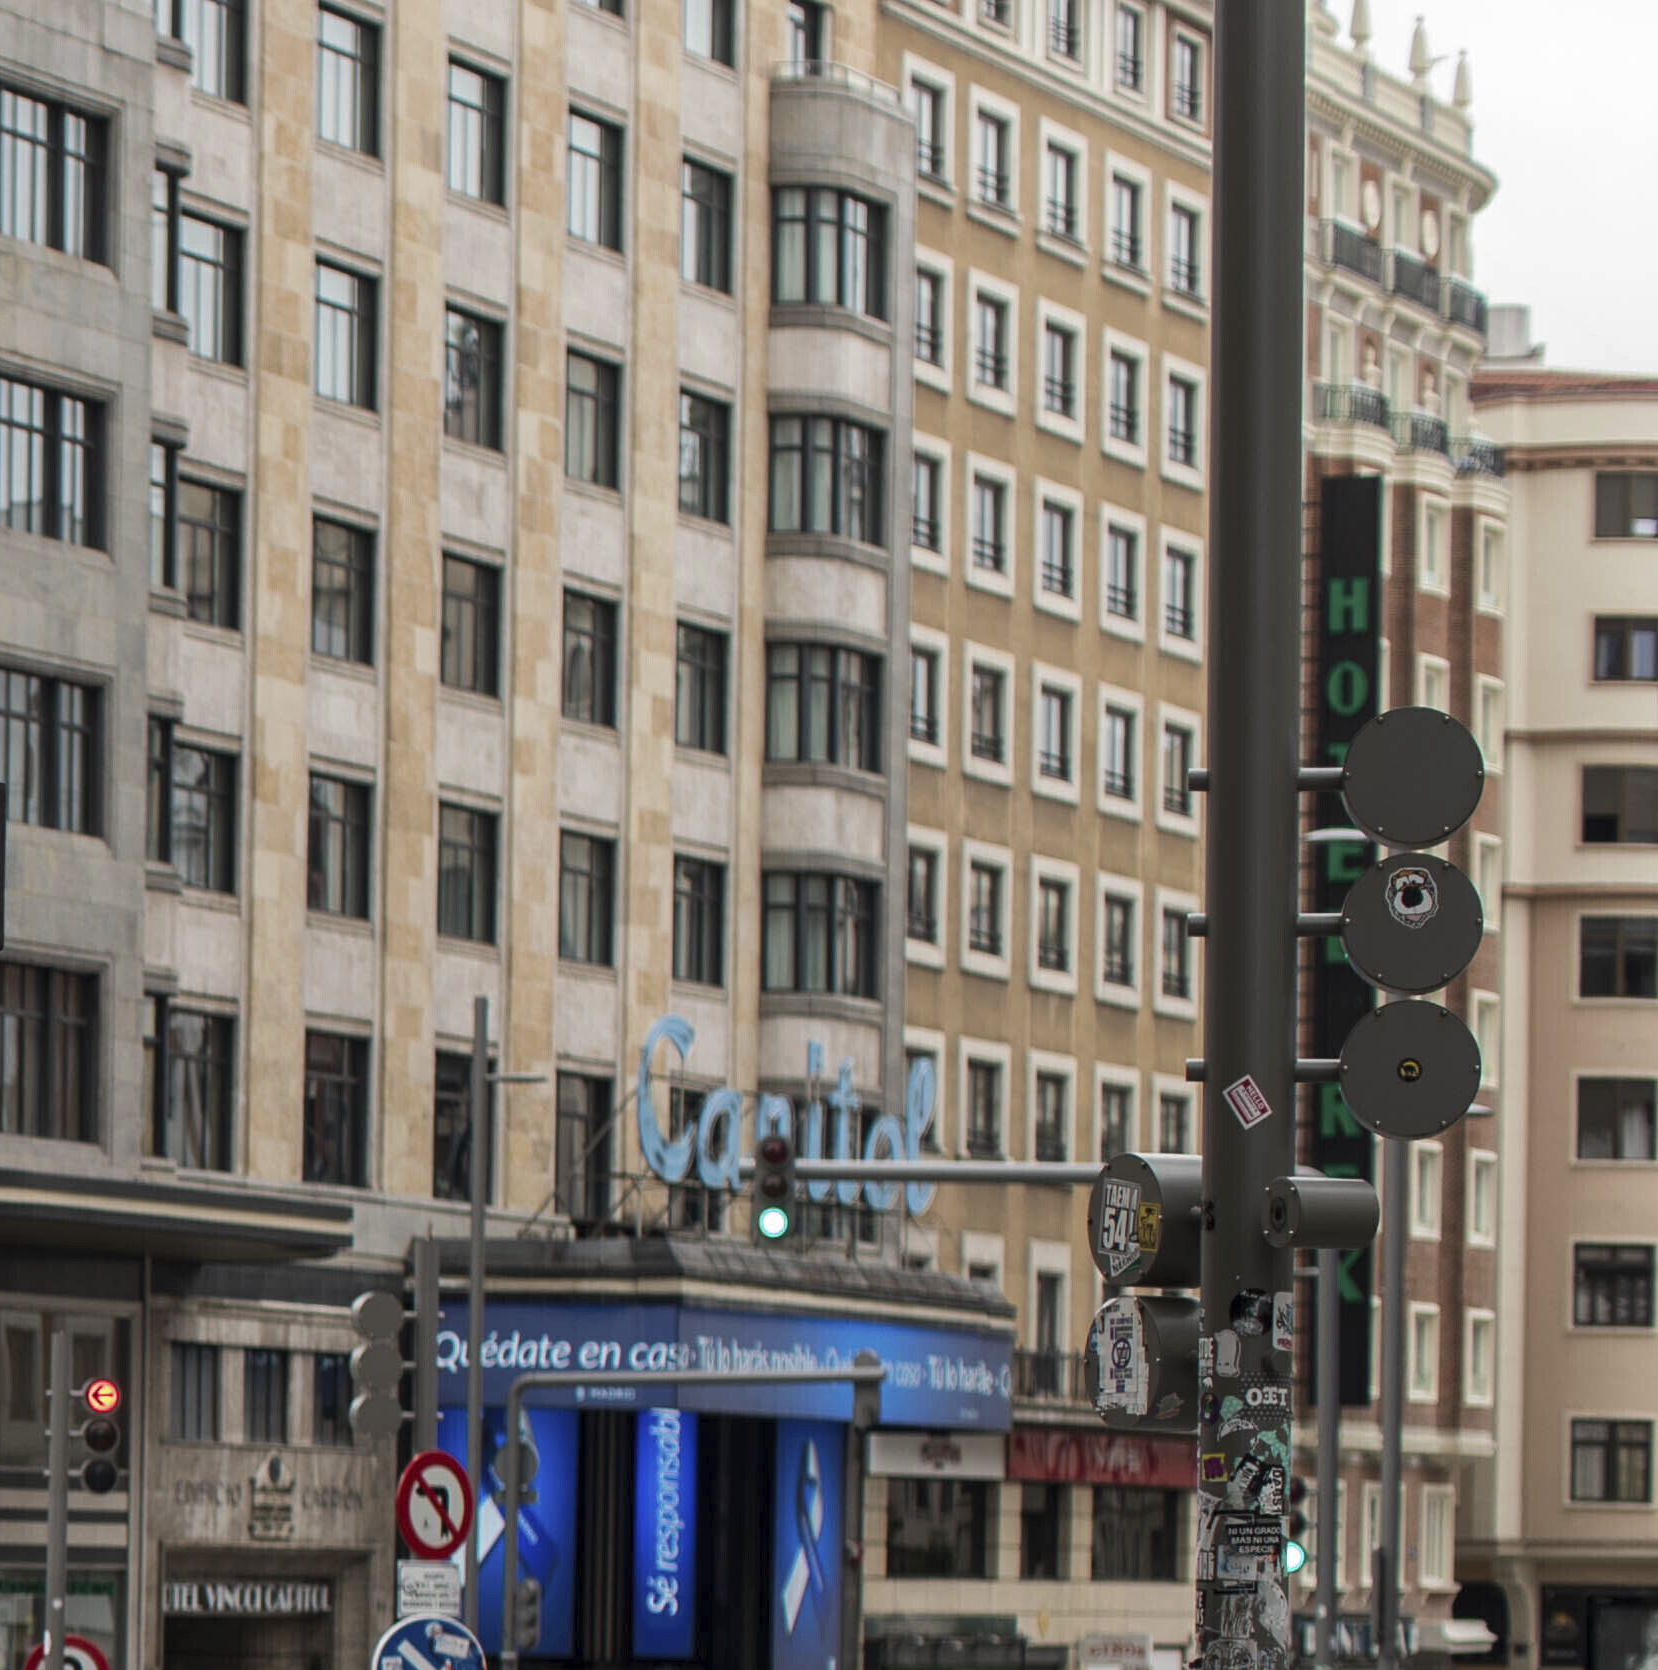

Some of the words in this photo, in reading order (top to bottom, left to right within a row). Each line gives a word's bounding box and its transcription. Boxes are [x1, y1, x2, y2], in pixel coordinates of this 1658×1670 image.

[434, 1331, 572, 1370] Quédate
[579, 1337, 622, 1369] en
[1239, 1526, 1253, 1536] UN
[648, 1574, 679, 1616] Sé
